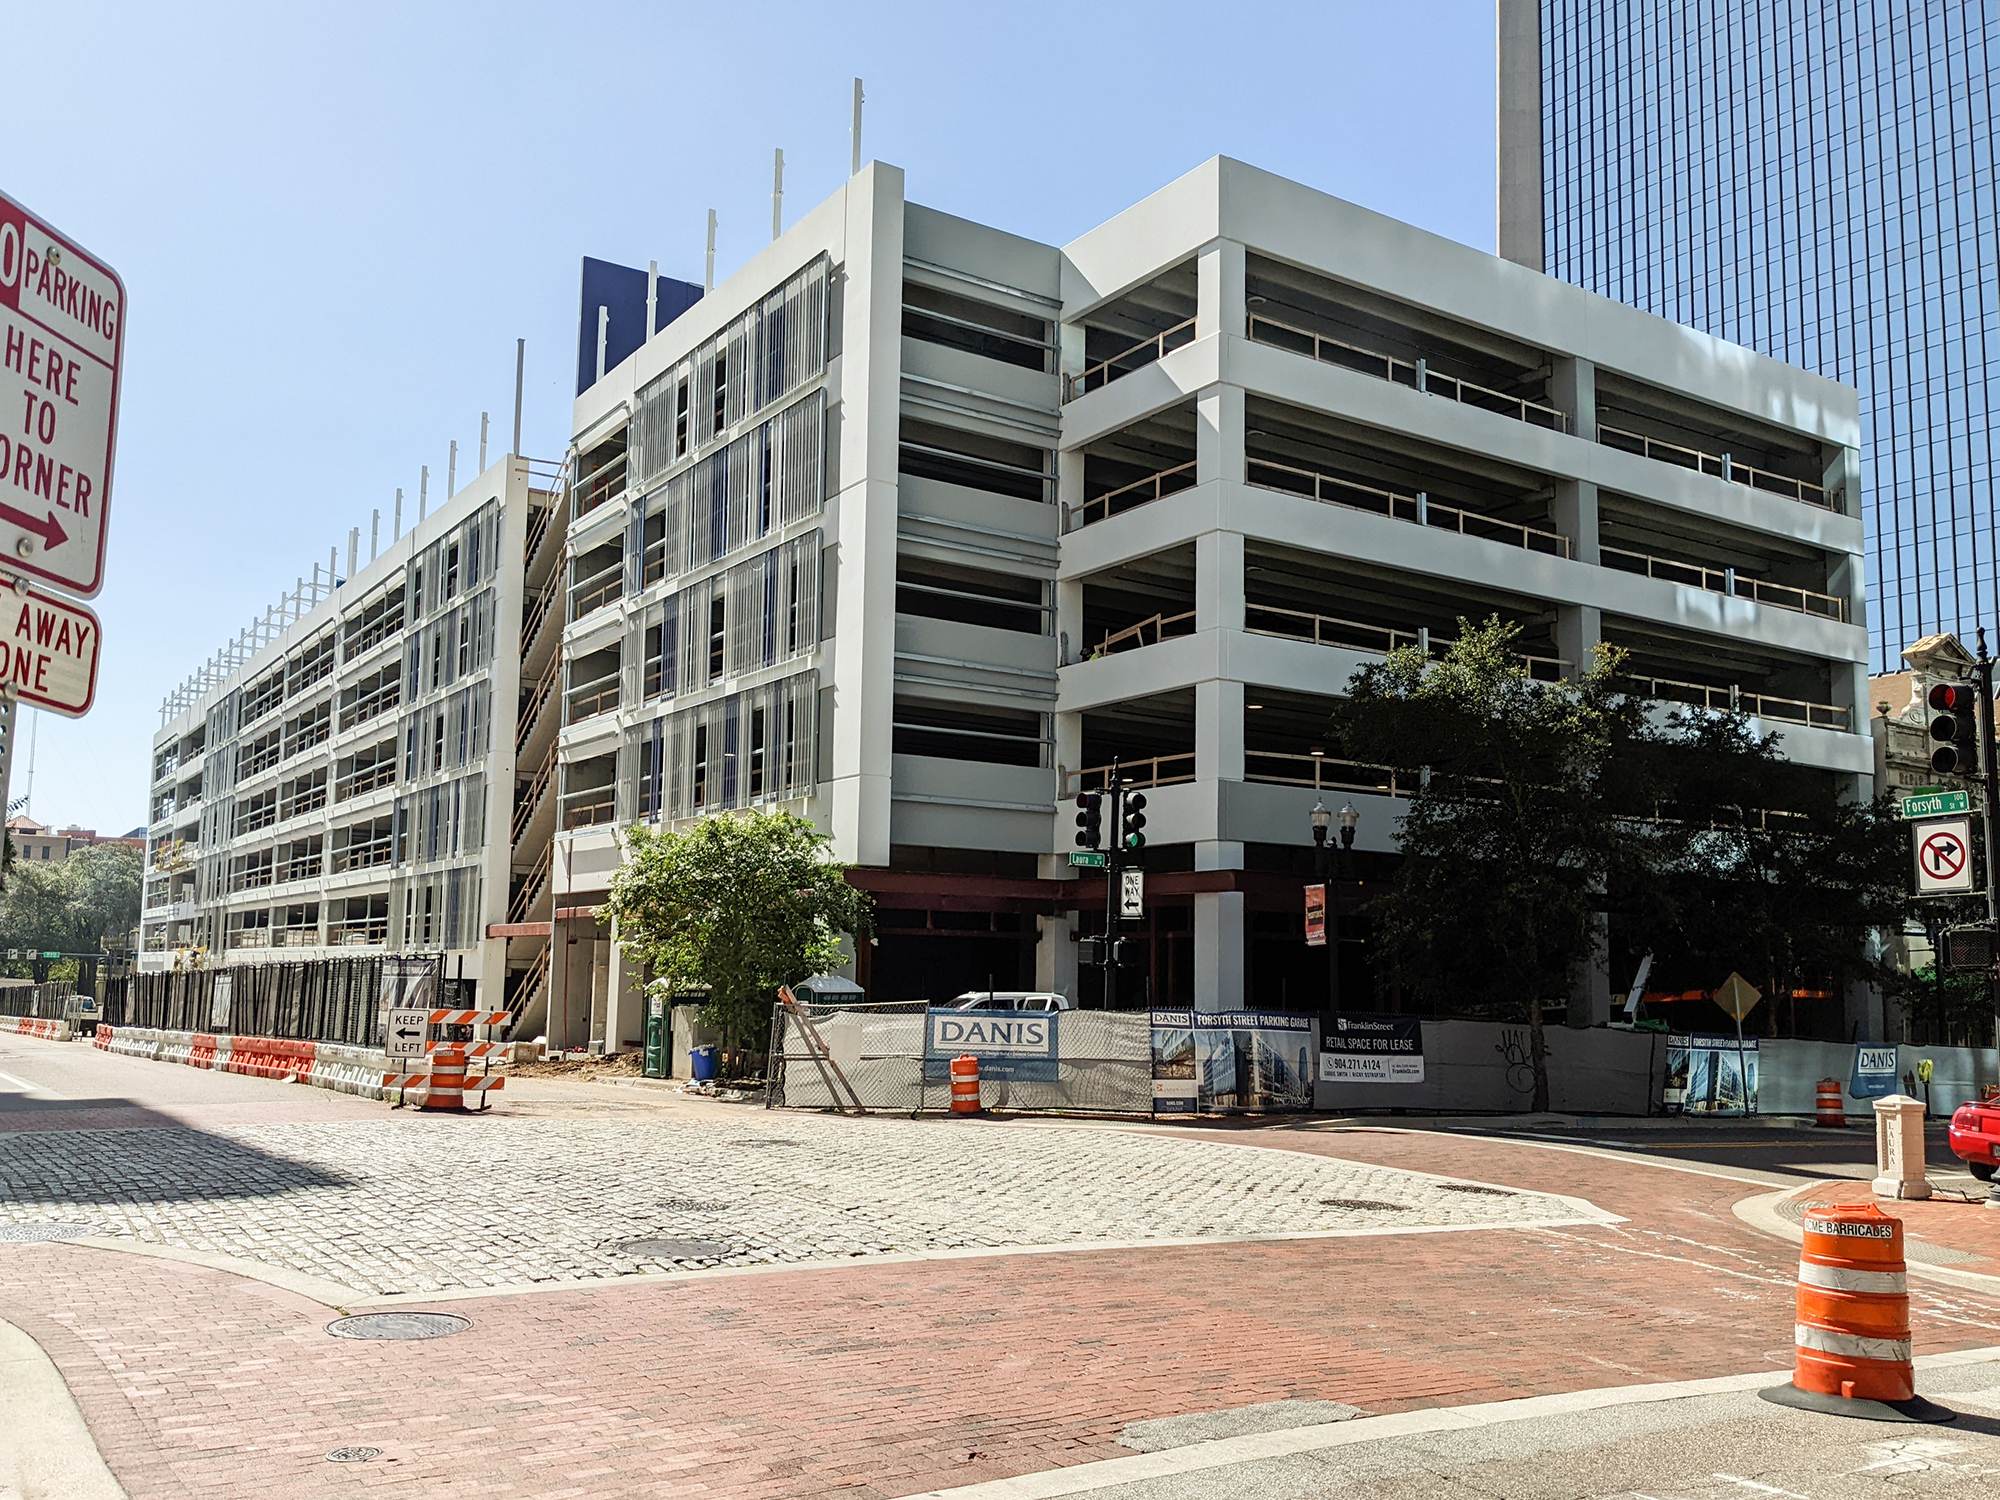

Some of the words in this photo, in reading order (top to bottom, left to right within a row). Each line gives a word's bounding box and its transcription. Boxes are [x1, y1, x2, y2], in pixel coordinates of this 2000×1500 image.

[0, 222, 20, 288] O
[25, 248, 115, 340] PARKING
[5, 324, 81, 406] HERE
[24, 389, 56, 445] TO
[0, 433, 93, 518] ORNER
[15, 602, 90, 659] AWAY
[0, 640, 52, 693] ONE
[1905, 796, 1942, 814] Forsyth
[1072, 853, 1089, 865] Laura
[1125, 875, 1139, 885] ONE
[1125, 887, 1139, 897] WAY
[395, 1015, 424, 1026] KEEP
[1154, 1014, 1188, 1024] DANIS
[1197, 1014, 1231, 1026] FORSYTH
[1232, 1014, 1259, 1026] STREET
[1259, 1015, 1290, 1028] PARKING
[1290, 1016, 1309, 1028] GARAGE
[940, 1021, 1044, 1044] DANIS
[394, 1042, 422, 1053] LEFT
[1326, 1036, 1347, 1049] RETAIL
[1347, 1037, 1371, 1050] SPACE
[1372, 1038, 1389, 1050] FOR
[1390, 1039, 1414, 1051] LEASE
[1669, 1036, 1688, 1045] DANIS
[1693, 1037, 1711, 1048] FORSYTH
[1711, 1038, 1725, 1048] STREET
[1725, 1039, 1740, 1049] PARKIN
[1334, 1058, 1381, 1070] 904.271.4124
[1860, 1052, 1894, 1068] DANIS
[978, 1065, 1015, 1073] w.danis.com
[1887, 1121, 1896, 1165] LAURA
[1826, 1222, 1892, 1237] BARRICADES
